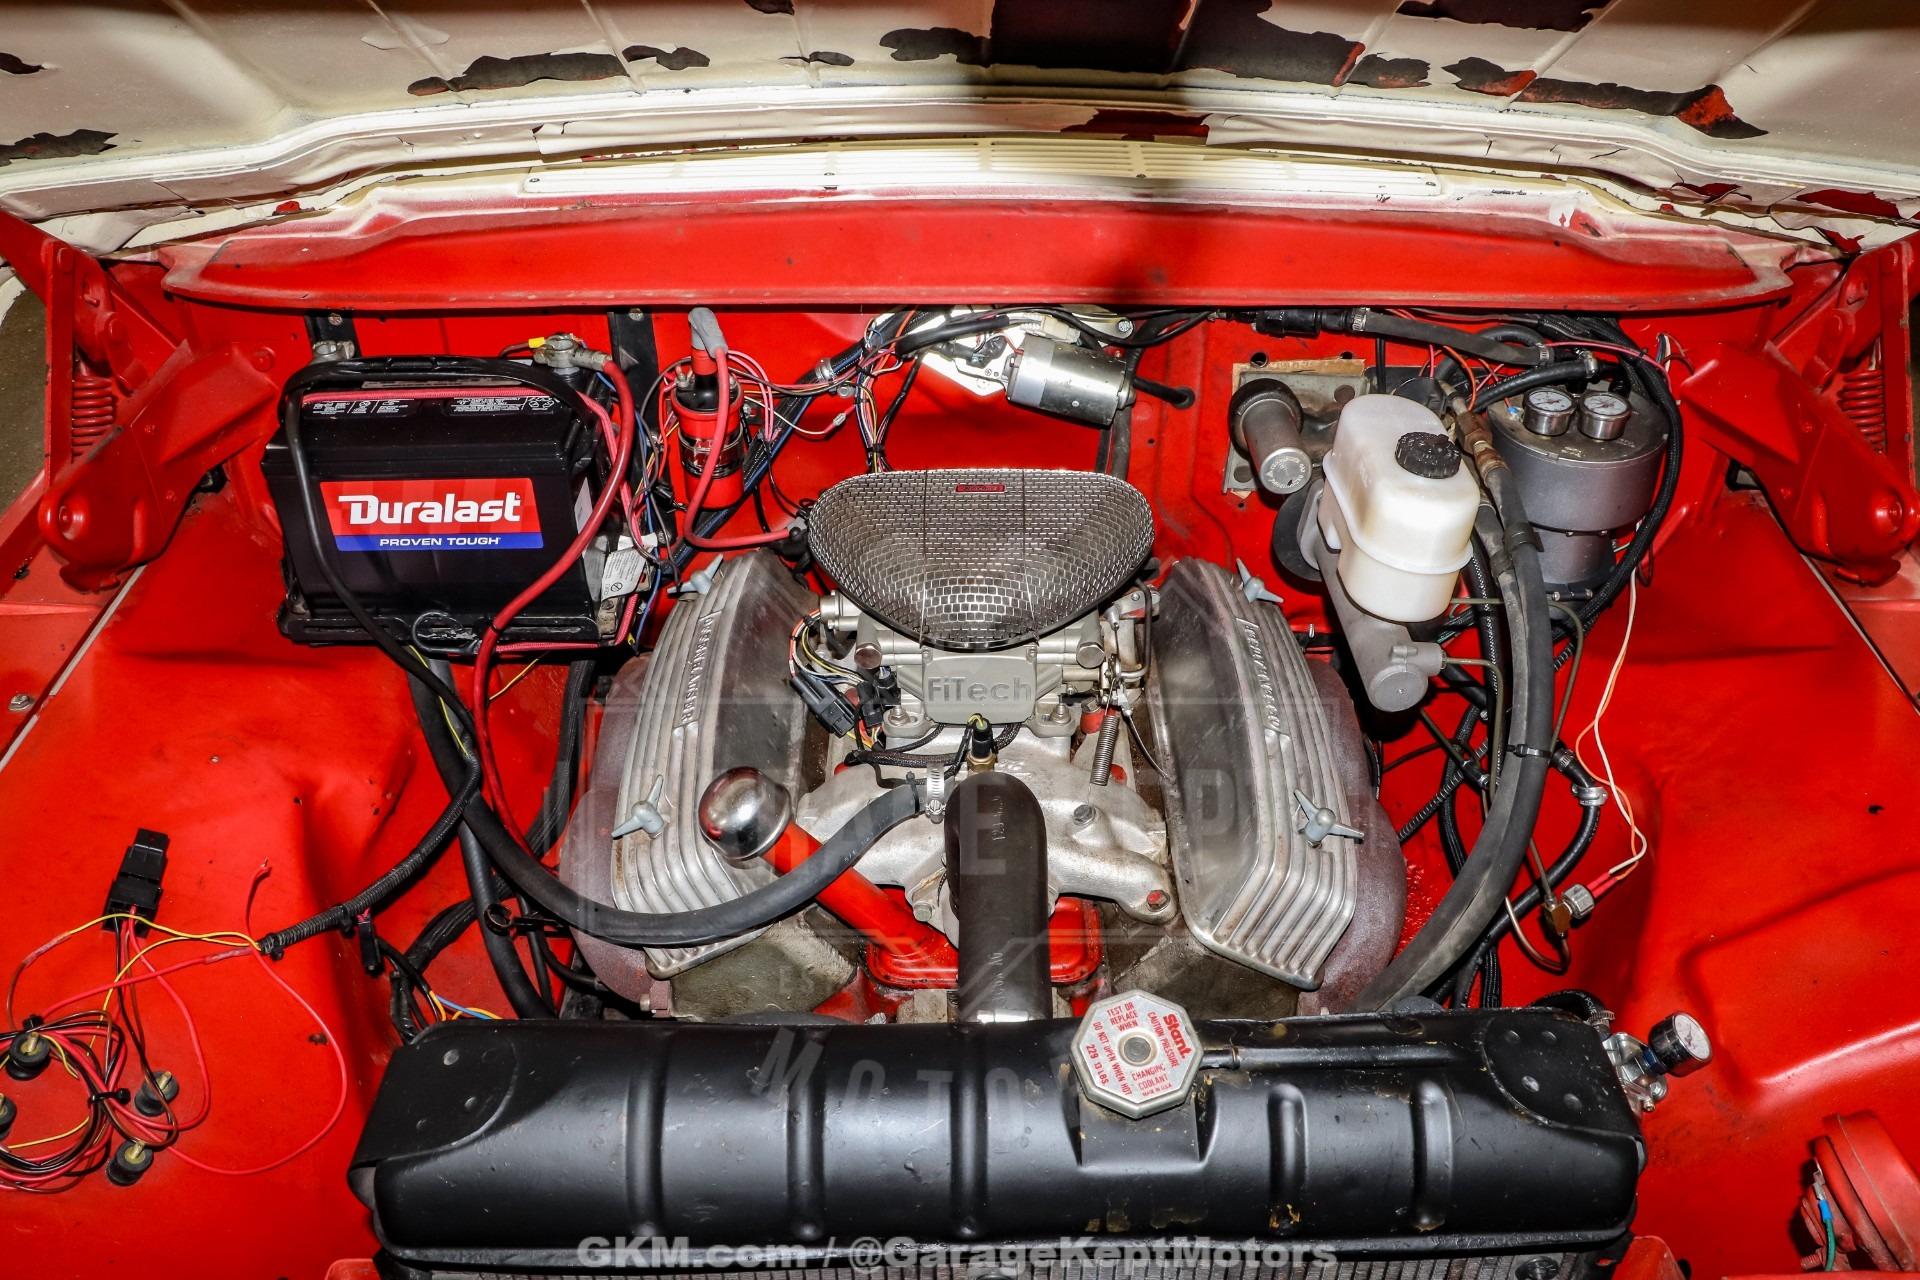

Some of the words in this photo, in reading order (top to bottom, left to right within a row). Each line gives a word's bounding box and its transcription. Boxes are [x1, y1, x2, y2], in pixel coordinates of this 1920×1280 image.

[337, 492, 521, 524] Duralast
[380, 537, 442, 546] PROVEN
[447, 536, 499, 546] TOUGH
[927, 676, 1032, 701] FiTech
[1106, 1005, 1123, 1017] TEST
[1124, 1002, 1135, 1011] OR
[1110, 1010, 1139, 1025] REPLACE
[1118, 1020, 1139, 1032] WHEN
[1097, 1030, 1110, 1045] NOT
[1147, 1011, 1164, 1037] CAUTION
[1160, 1036, 1180, 1067] PRESSURE
[1163, 1013, 1192, 1058] Stant
[1085, 1043, 1099, 1059] 229
[1094, 1062, 1103, 1070] 13
[1103, 1044, 1117, 1062] OPEN
[1112, 1062, 1126, 1082] WHEN
[1120, 1082, 1133, 1095] HOT
[1138, 1073, 1169, 1090] COOLANT
